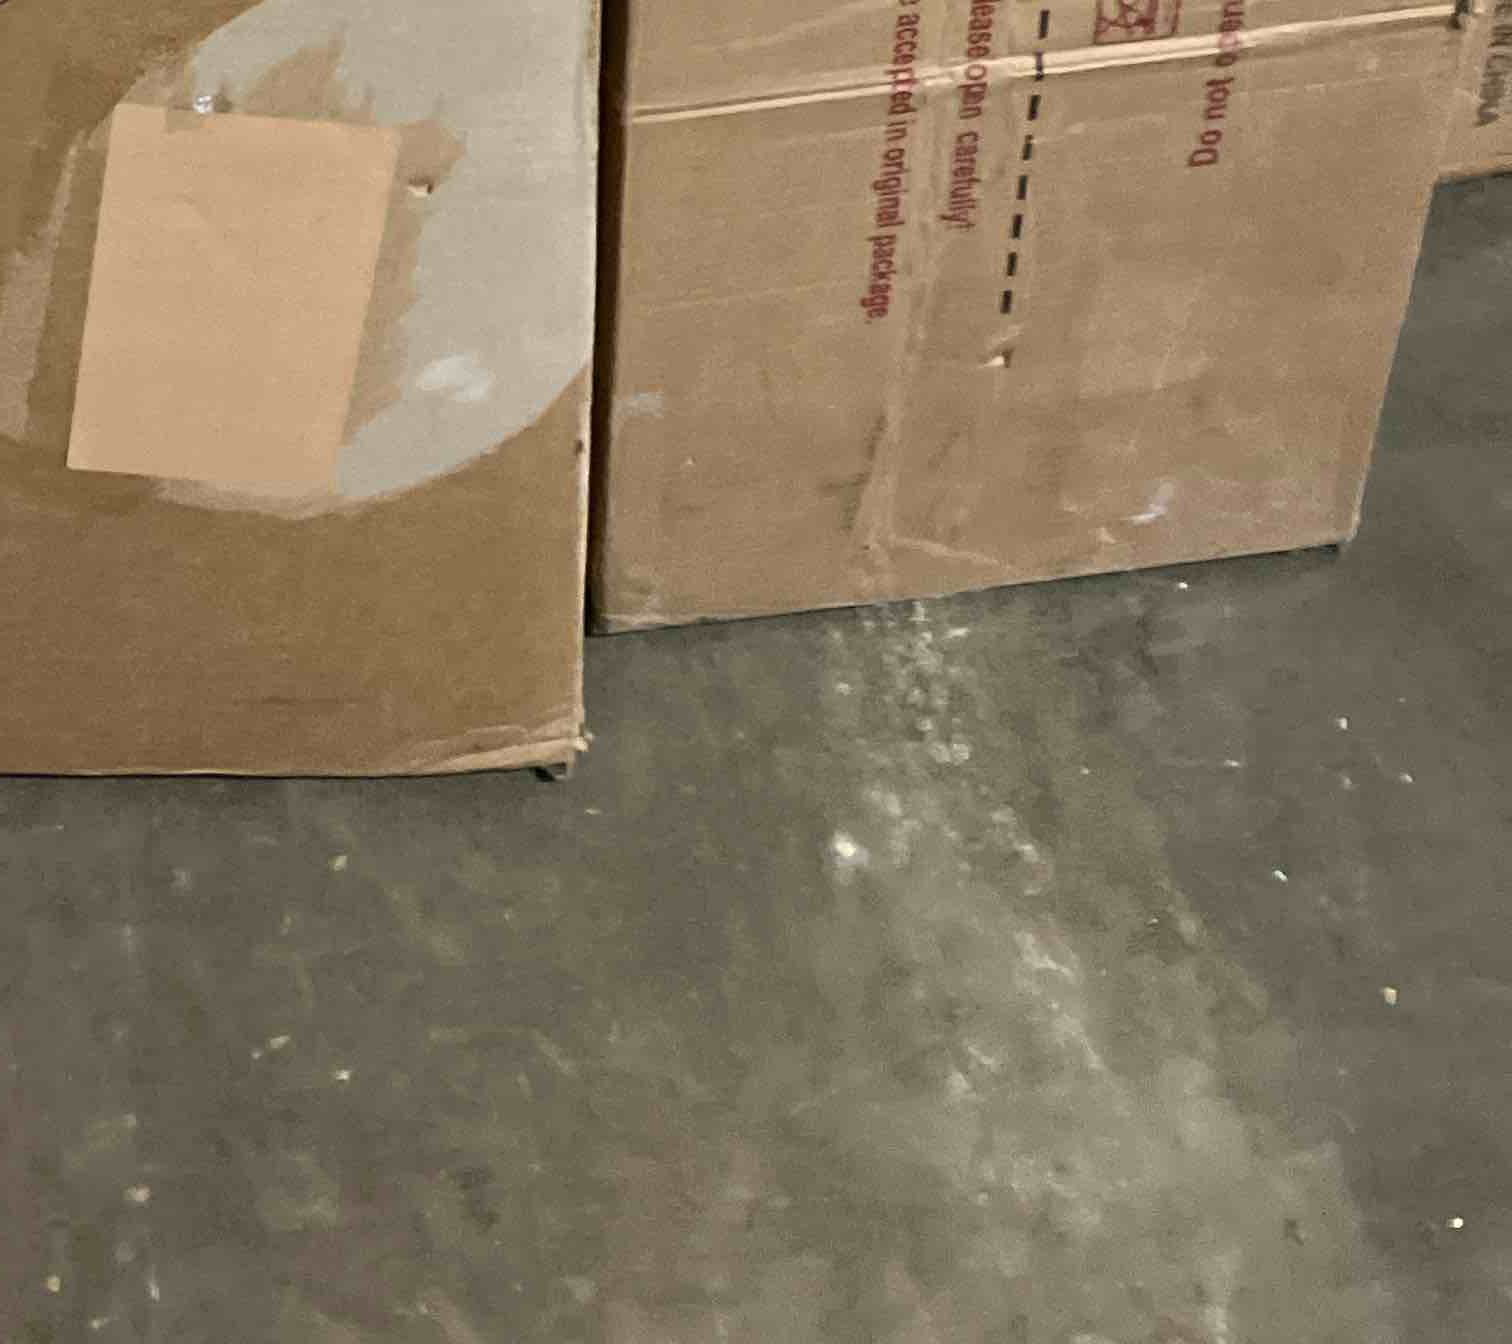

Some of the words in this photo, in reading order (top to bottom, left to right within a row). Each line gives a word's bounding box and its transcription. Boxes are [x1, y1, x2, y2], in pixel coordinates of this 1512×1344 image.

[884, 12, 921, 115] accepted
[1204, 75, 1235, 121] not
[886, 118, 916, 148] in
[1187, 128, 1222, 169] Do
[872, 148, 912, 229] original
